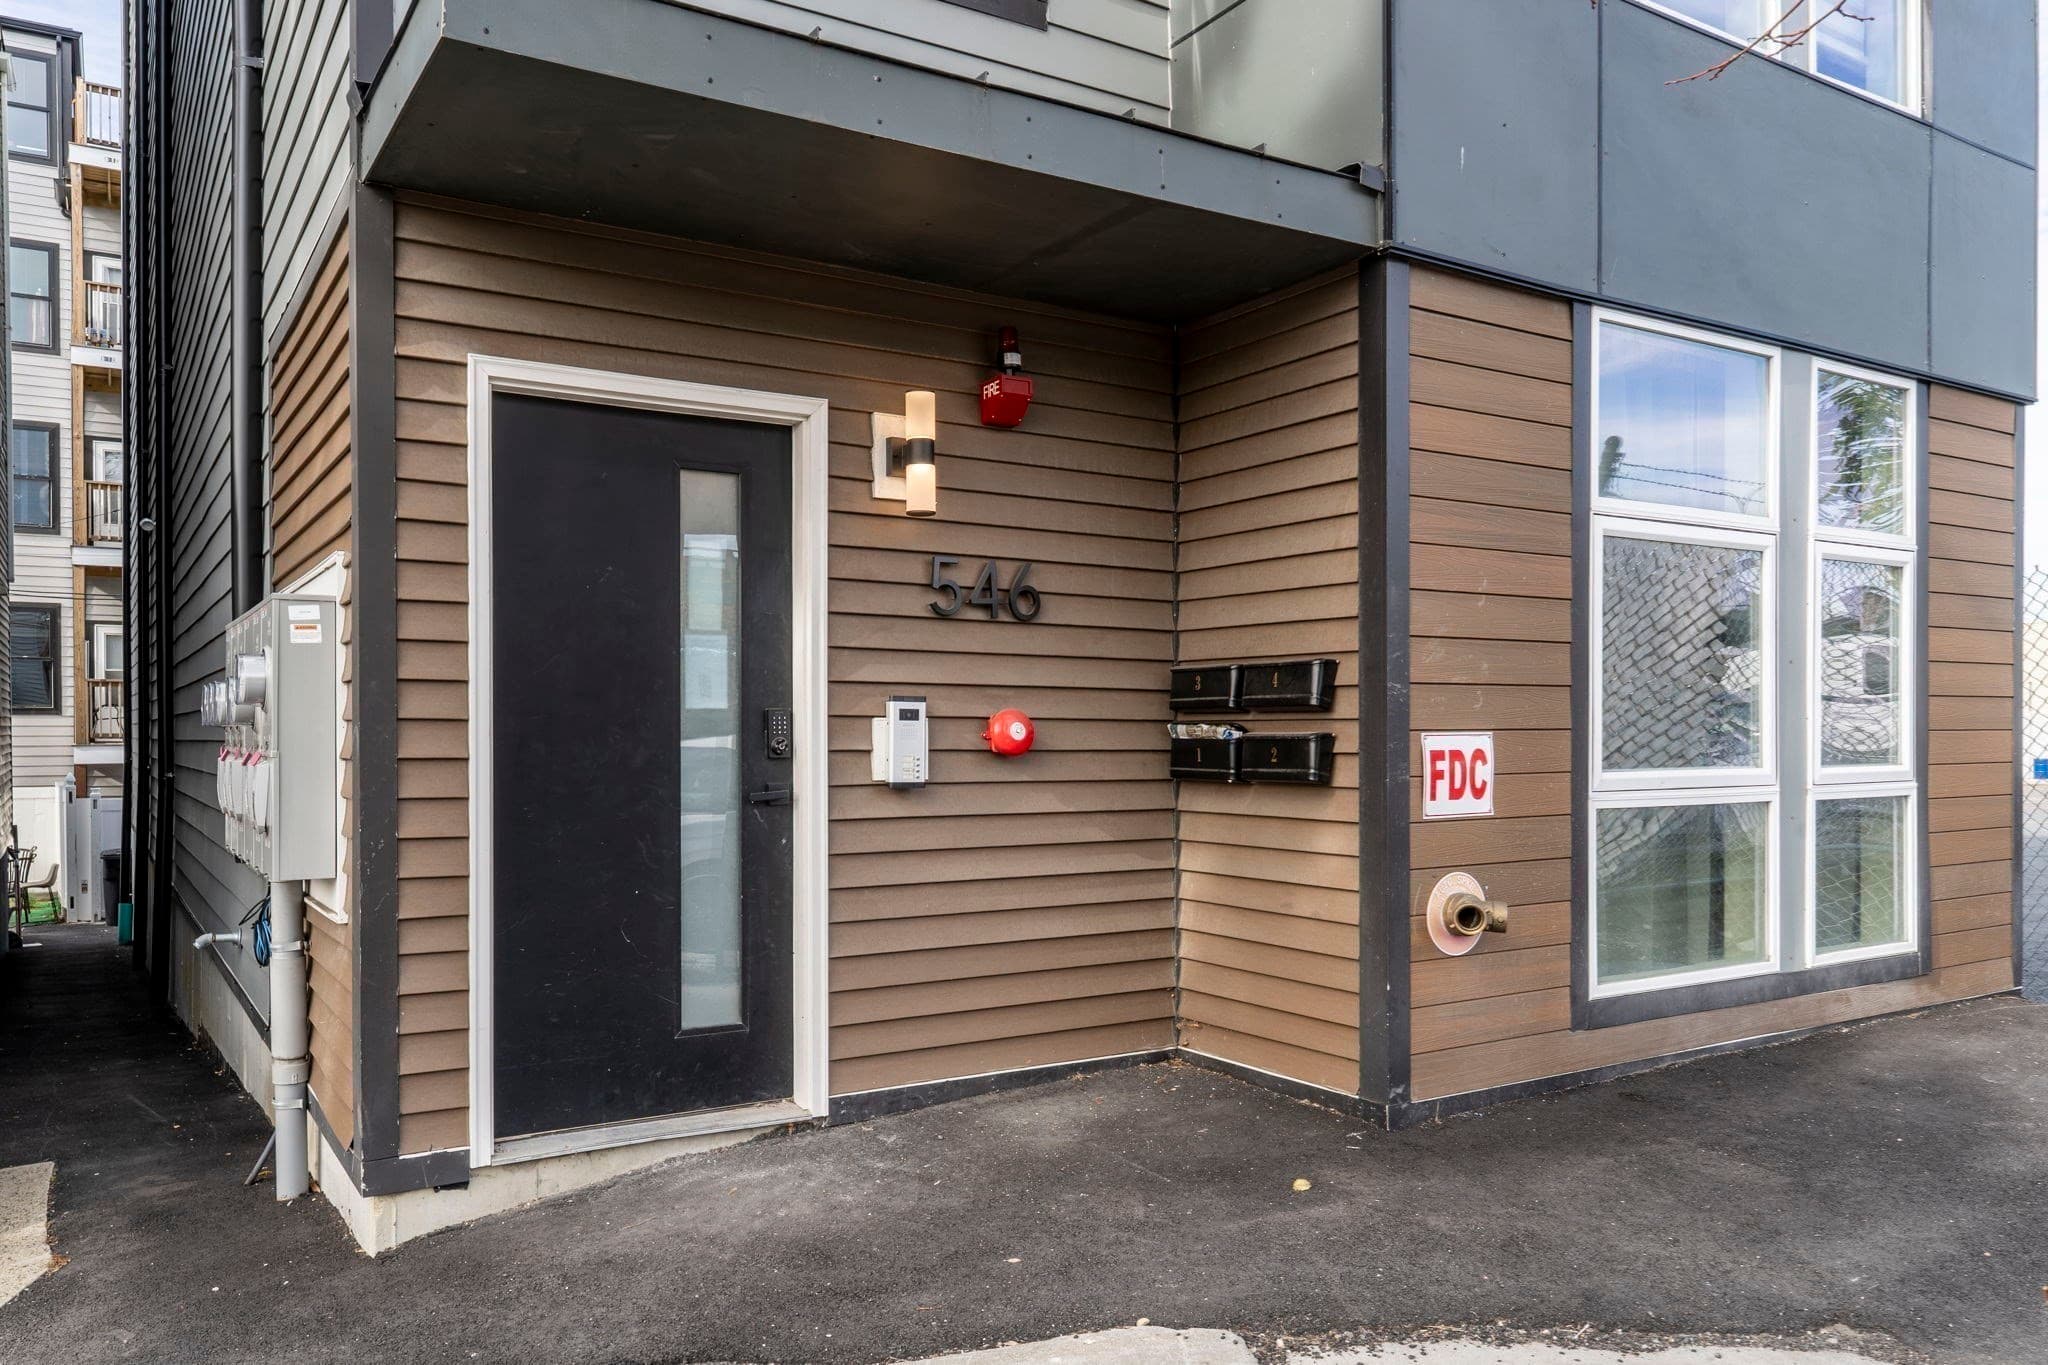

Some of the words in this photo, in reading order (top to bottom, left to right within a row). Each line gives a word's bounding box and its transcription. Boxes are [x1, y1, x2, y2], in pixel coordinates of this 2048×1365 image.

[983, 380, 1000, 400] FIRE
[929, 555, 1041, 621] 546
[1194, 675, 1201, 691] 3
[1272, 672, 1280, 688] 4
[1196, 748, 1201, 763] 1
[1271, 747, 1278, 763] 2
[1429, 748, 1488, 801] FDC
